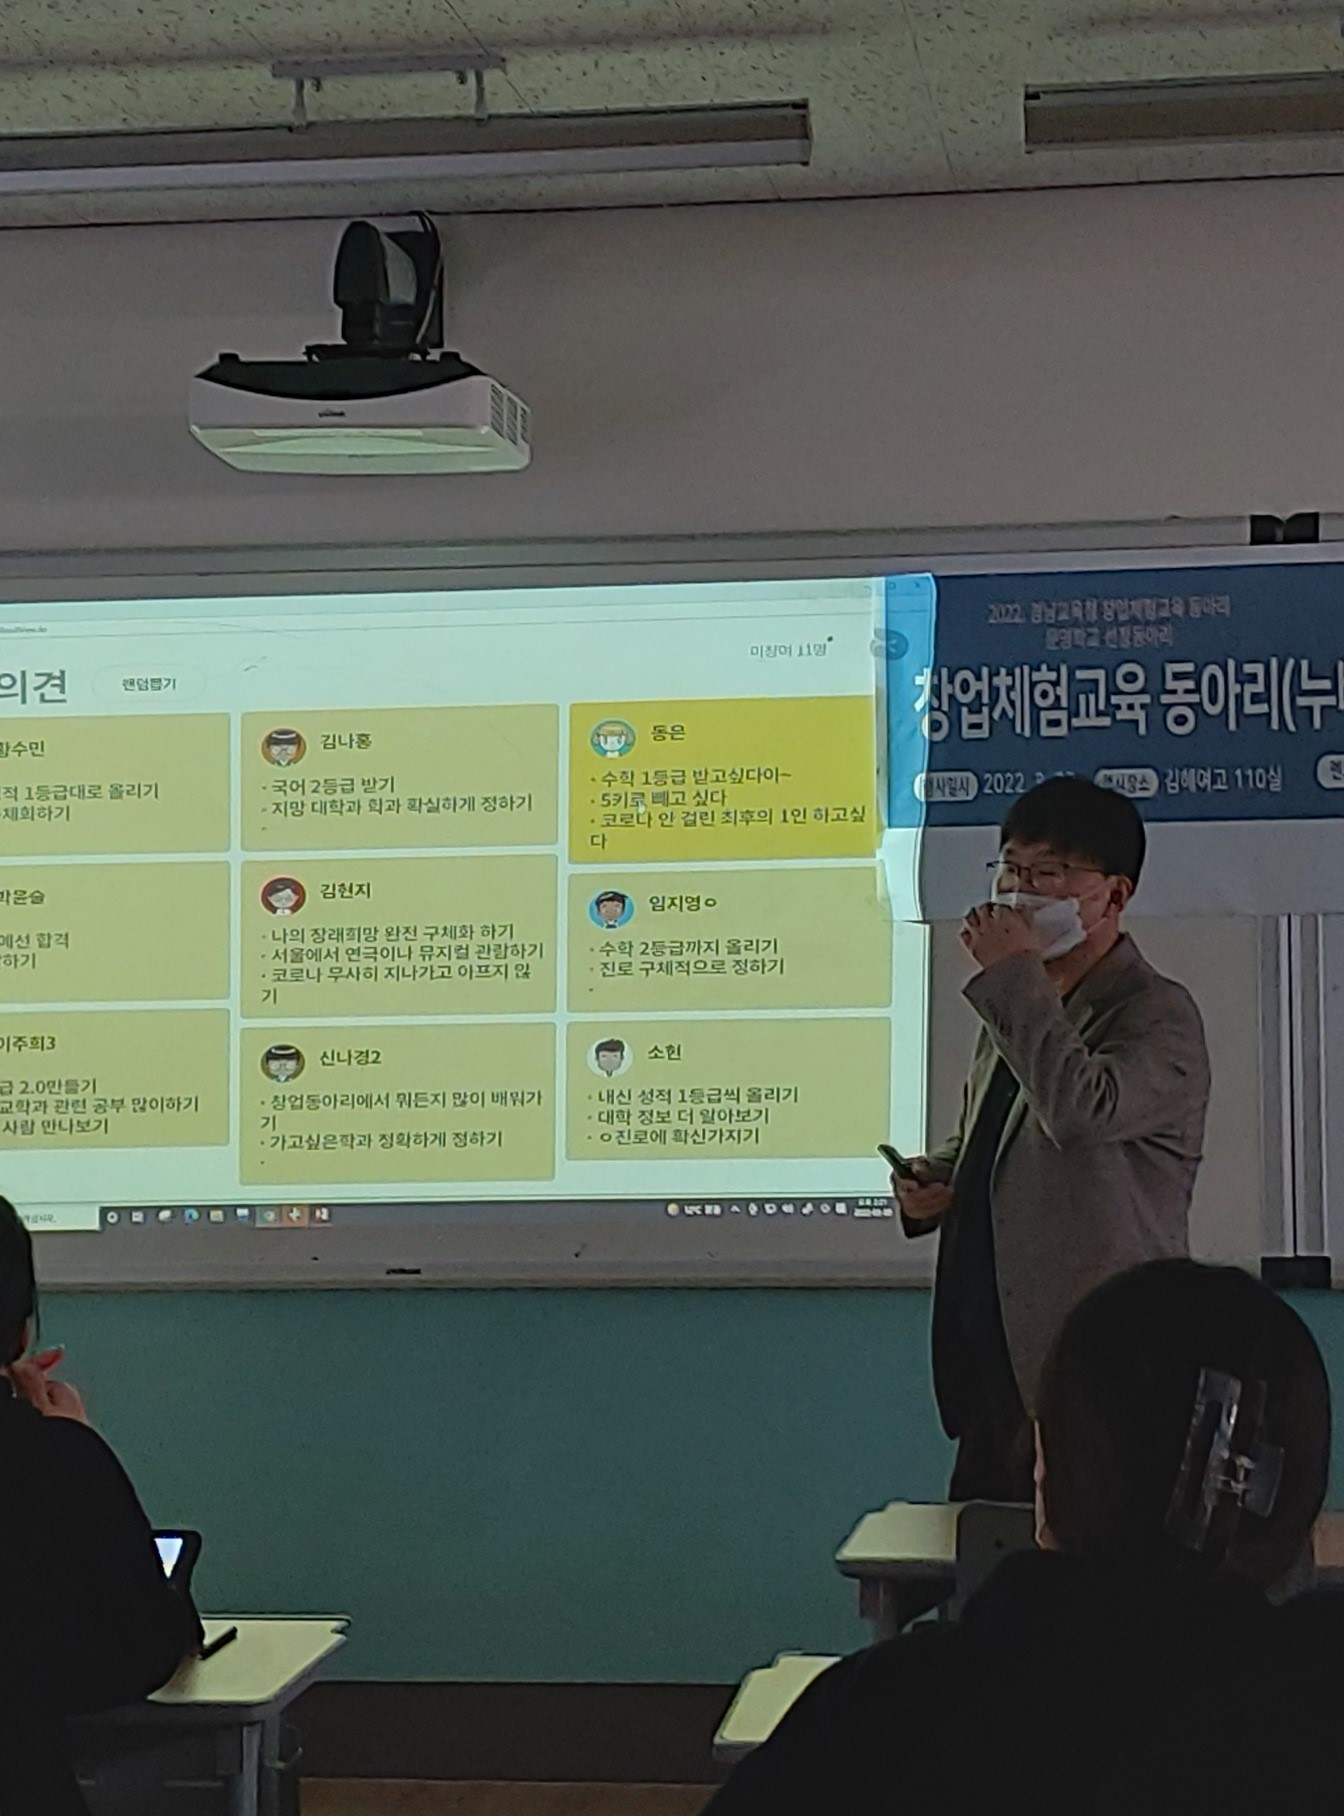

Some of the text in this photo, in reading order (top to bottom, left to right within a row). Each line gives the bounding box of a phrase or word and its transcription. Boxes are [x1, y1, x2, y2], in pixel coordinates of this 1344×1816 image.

[122, 677, 177, 692] 랜덤뽑기
[913, 660, 1152, 742] 창업체험교육
[651, 724, 686, 741] 동은
[272, 776, 395, 796] 국어 2등급 받기
[601, 770, 635, 788] 수학
[641, 769, 687, 786] 1등급
[1164, 767, 1229, 794] 김해여고
[1234, 764, 1283, 792] 110실
[24, 784, 103, 801] 1등급대로
[108, 783, 159, 800] 올리기
[652, 790, 687, 807] 빼고
[692, 789, 727, 806] 싶다
[272, 800, 305, 817] 지망
[311, 798, 361, 816] 대학과
[481, 794, 532, 812] 정하기
[601, 806, 866, 829] 코로나 안 걸린 최후의 1인 하고싶
[590, 834, 608, 850] 다
[320, 882, 371, 899] 김현지
[37, 932, 70, 949] 합격
[272, 923, 514, 944] 나의 장래희망 완전 구체화 하기
[272, 942, 544, 964] 서울에서 연극이나 뮤지컬 관람하기
[599, 938, 778, 958] 수학 2등급까지 올리기
[271, 967, 321, 984] 코로나
[328, 965, 378, 982] 무사히
[384, 964, 452, 981] 지나가고
[458, 963, 508, 980] 아프지
[599, 958, 784, 978] 진로 구체적으로 정하기
[261, 988, 278, 1004] 기
[19, 1078, 97, 1095] 2.0만들기
[598, 1086, 799, 1105] 내신 성적 1등급씩 올리기
[54, 1098, 87, 1115] 관련
[92, 1097, 126, 1114] 공부
[131, 1095, 199, 1113] 많이하기
[271, 1092, 390, 1110] 창업동아리에서
[395, 1091, 446, 1109] 뭐든지
[452, 1090, 485, 1108] 많이
[260, 1115, 277, 1132] 기
[598, 1107, 770, 1126] 대학 정보 더 알아보기
[2, 1119, 35, 1135] 사람
[42, 1118, 109, 1135] 만나보기
[270, 1132, 372, 1150] 가고싶은학과
